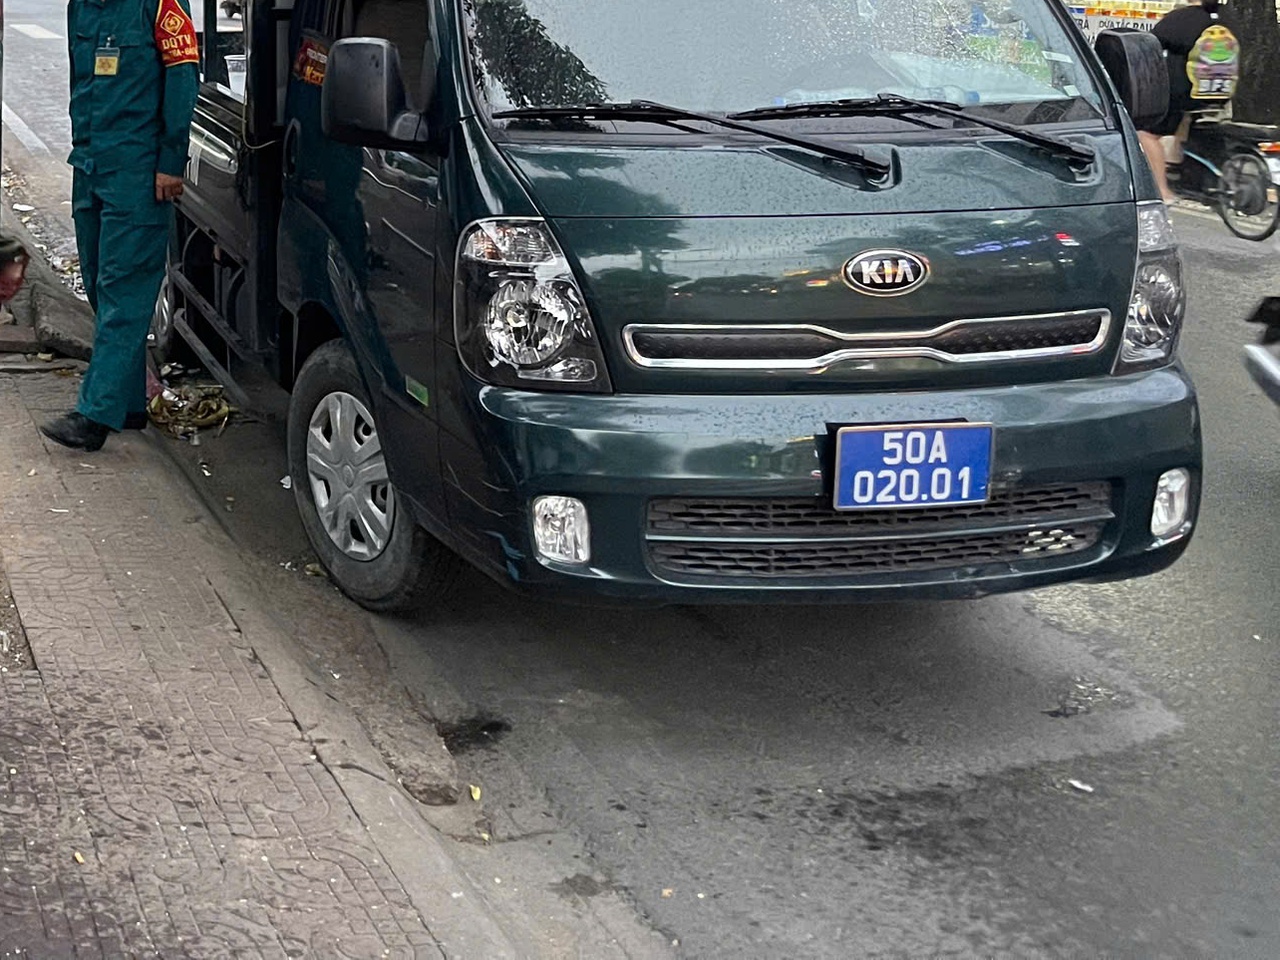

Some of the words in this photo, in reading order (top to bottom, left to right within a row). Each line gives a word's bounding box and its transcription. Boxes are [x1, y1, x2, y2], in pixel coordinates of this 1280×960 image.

[859, 259, 915, 284] KIA
[882, 430, 948, 466] 50A
[852, 466, 971, 504] 020.01
